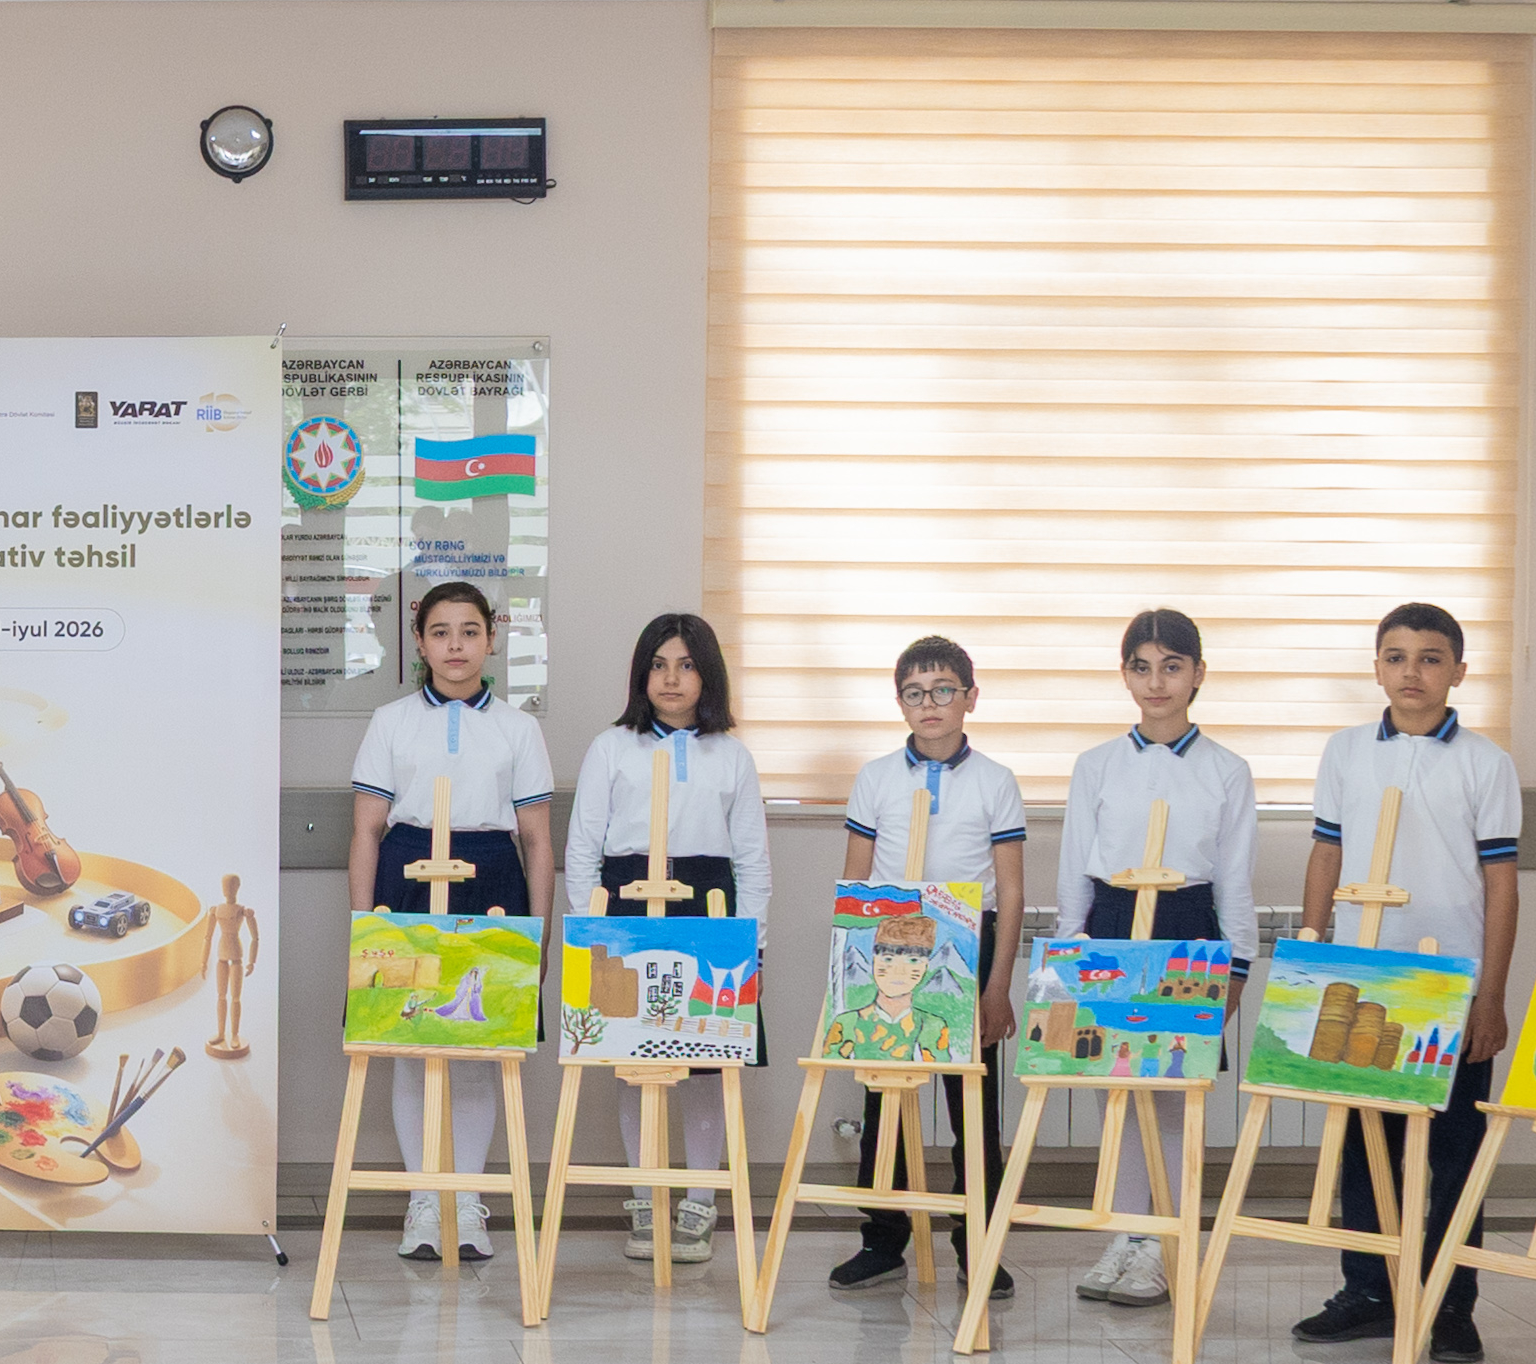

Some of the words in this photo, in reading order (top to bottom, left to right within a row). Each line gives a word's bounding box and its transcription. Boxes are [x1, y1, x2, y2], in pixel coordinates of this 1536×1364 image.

[429, 360, 512, 370] AZƏRBAYCAN
[283, 371, 378, 383] SPUBLİKASININ
[329, 385, 368, 397] GERBİ
[110, 401, 188, 418] YARAT
[51, 503, 252, 534] fəaliyyətlərlə
[435, 540, 465, 551] RƏNG
[54, 543, 136, 568] təhsil
[493, 555, 505, 563] VƏ
[55, 621, 104, 638] 2026
